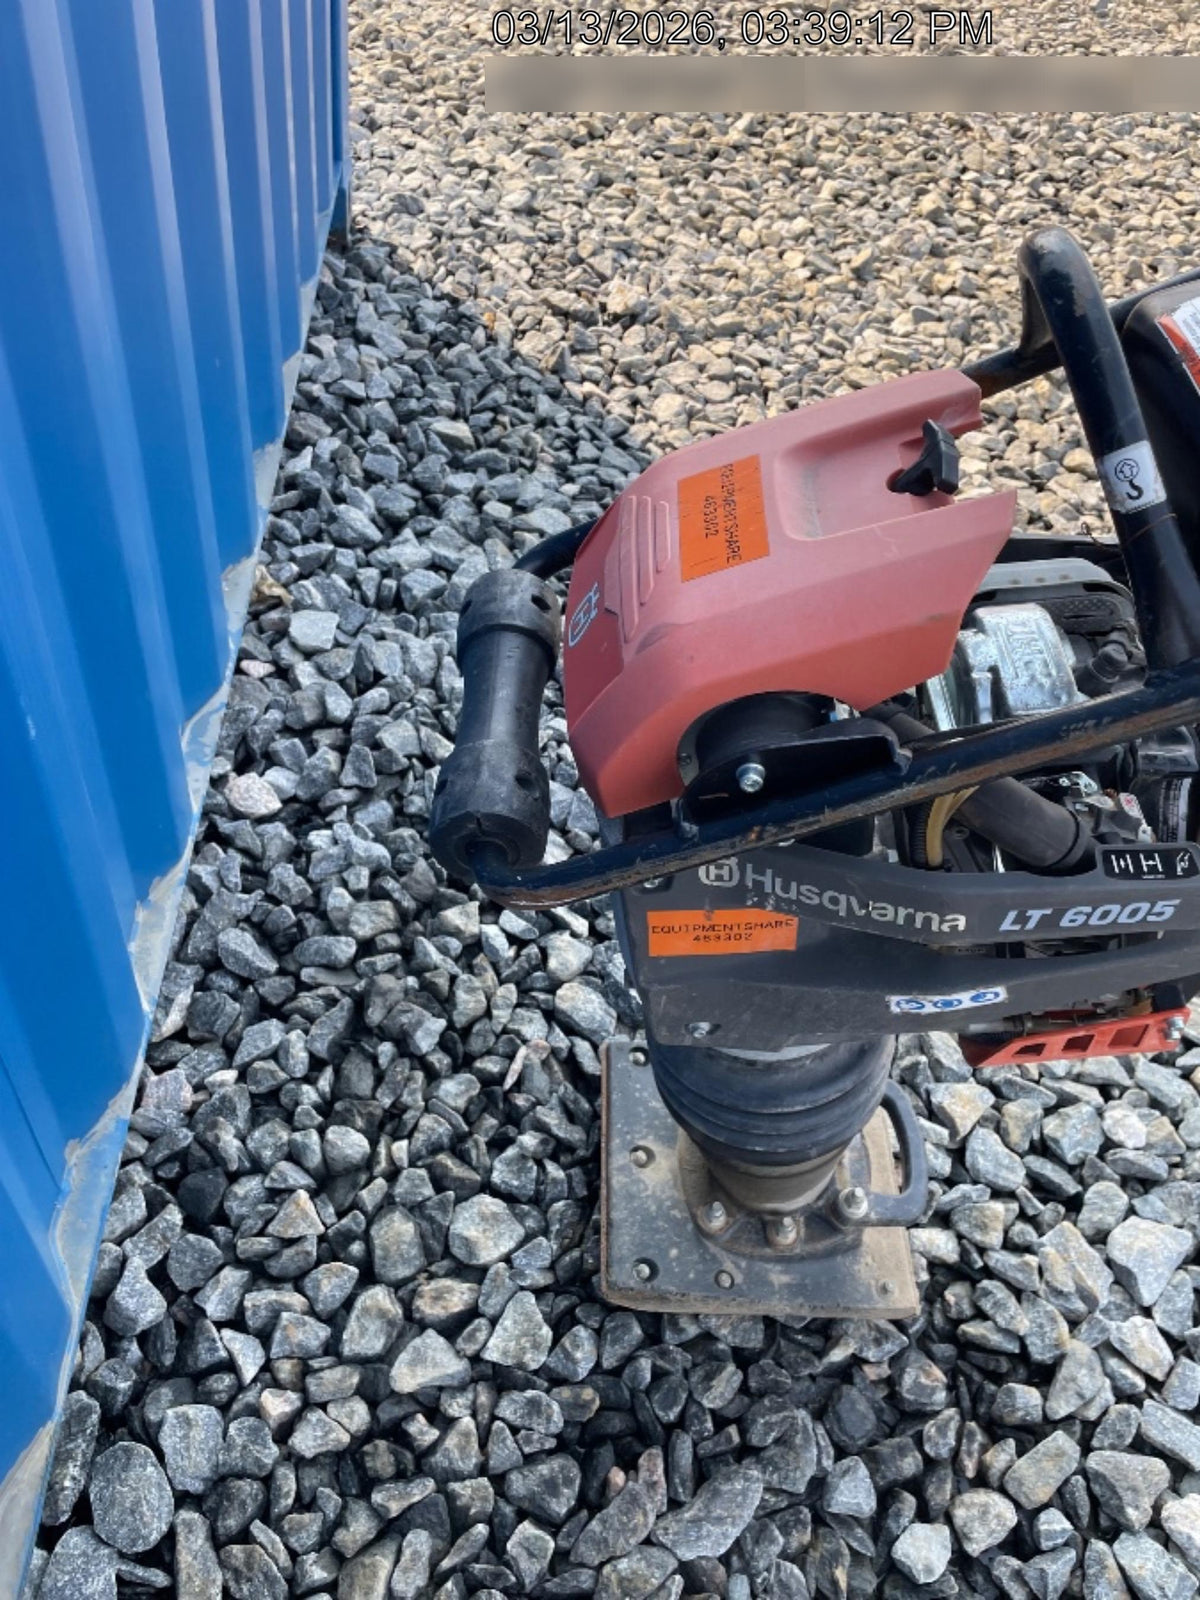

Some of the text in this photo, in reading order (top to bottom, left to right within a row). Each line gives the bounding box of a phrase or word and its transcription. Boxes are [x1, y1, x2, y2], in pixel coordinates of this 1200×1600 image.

[745, 863, 967, 932] Husqvarna
[651, 919, 795, 935] EQUIPMENTSHARE
[999, 899, 1182, 931] LT 6005
